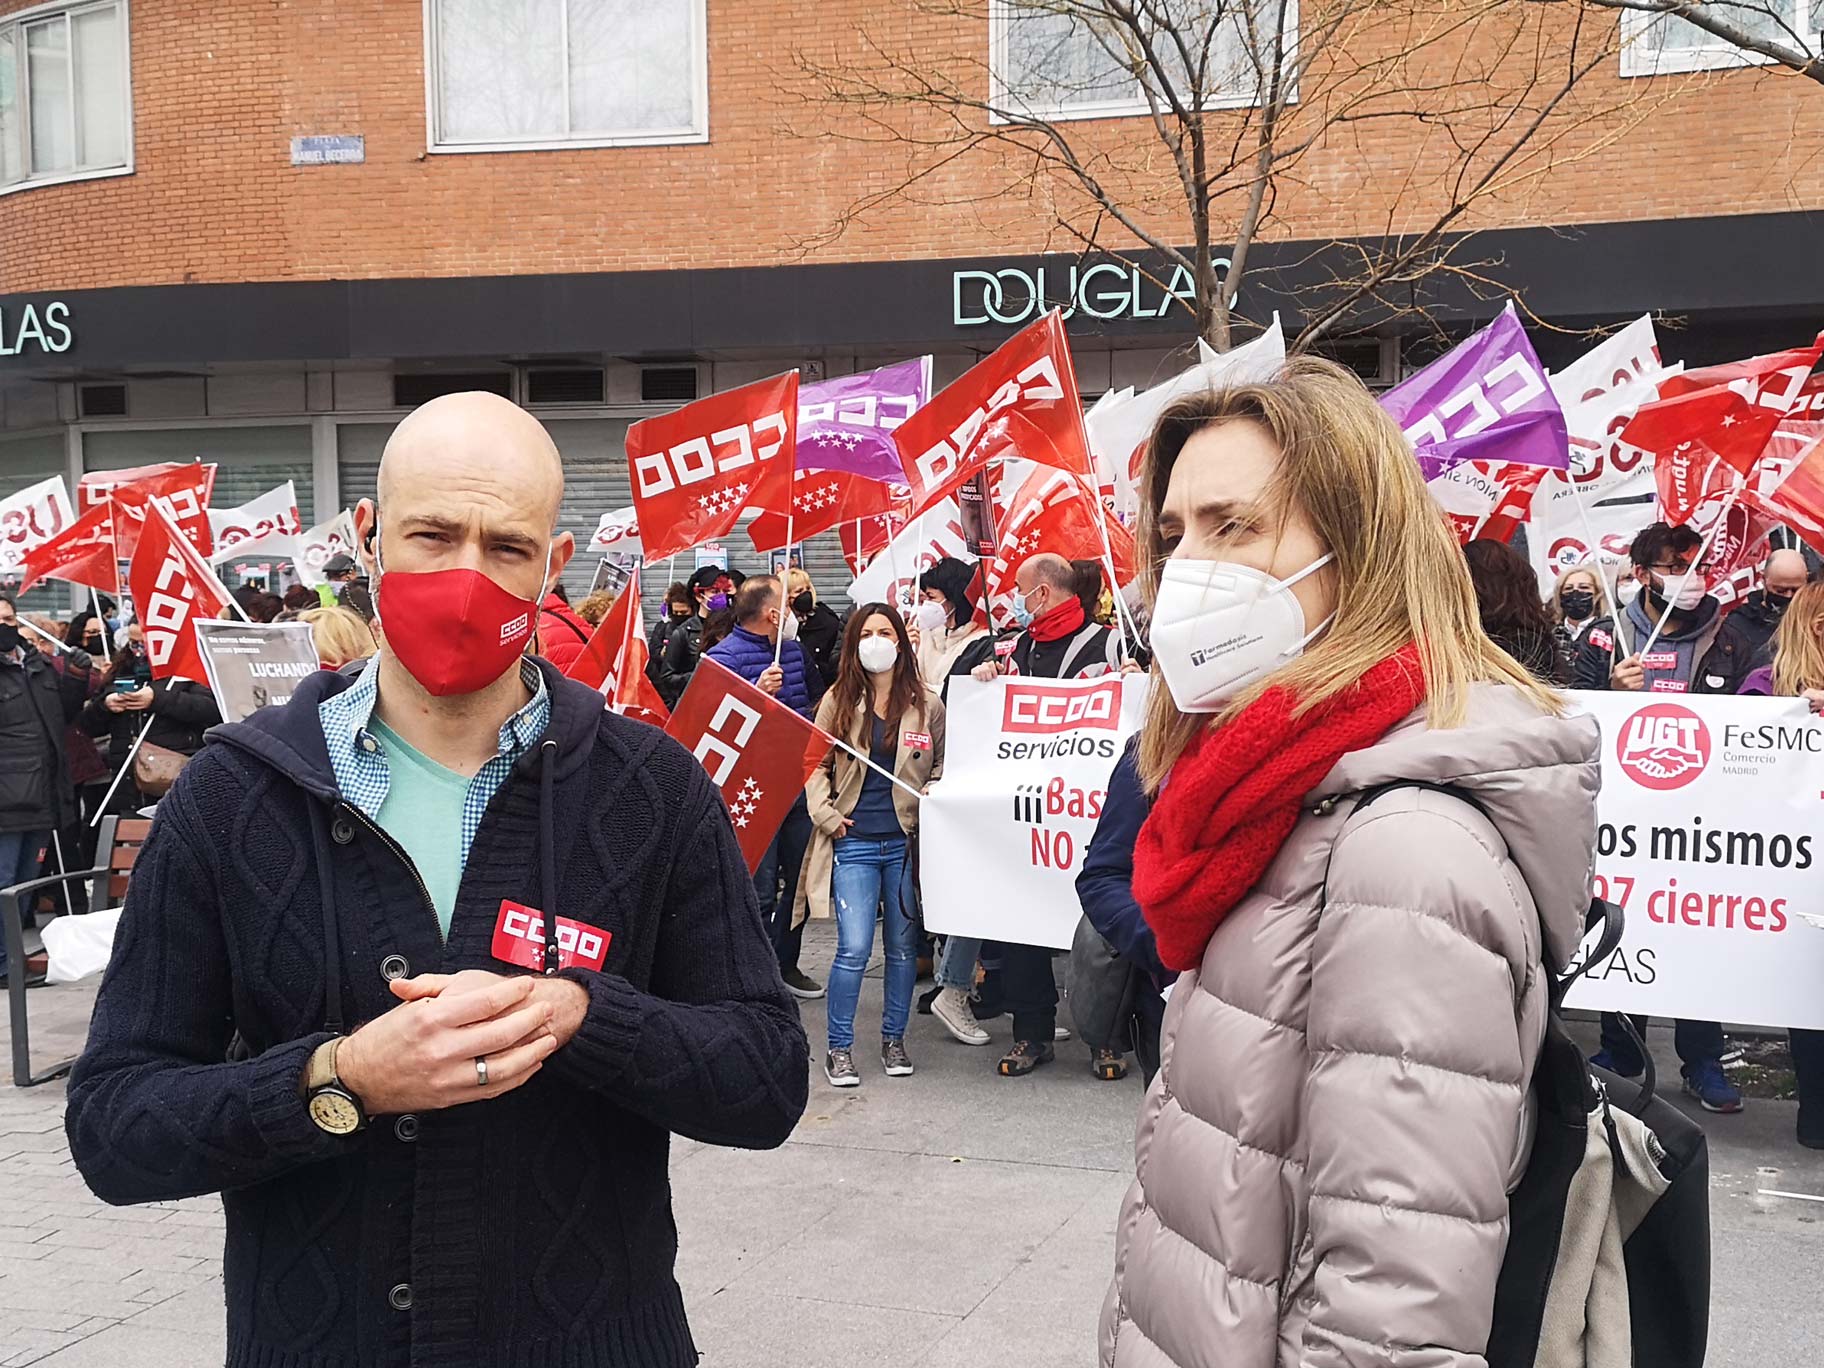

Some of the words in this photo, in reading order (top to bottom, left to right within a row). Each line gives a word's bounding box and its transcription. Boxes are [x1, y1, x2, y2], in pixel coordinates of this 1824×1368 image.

[501, 612, 528, 638] CCOO
[1011, 690, 1112, 726] CCOO
[997, 731, 1115, 760] servicios
[1628, 715, 1702, 752] UGT
[1723, 724, 1823, 753] FeSMC
[1722, 766, 1759, 776] MADRID
[1723, 751, 1777, 764] Comercio
[1031, 828, 1074, 871] NO
[1650, 816, 1813, 869] mismos
[1647, 878, 1787, 933] cierres
